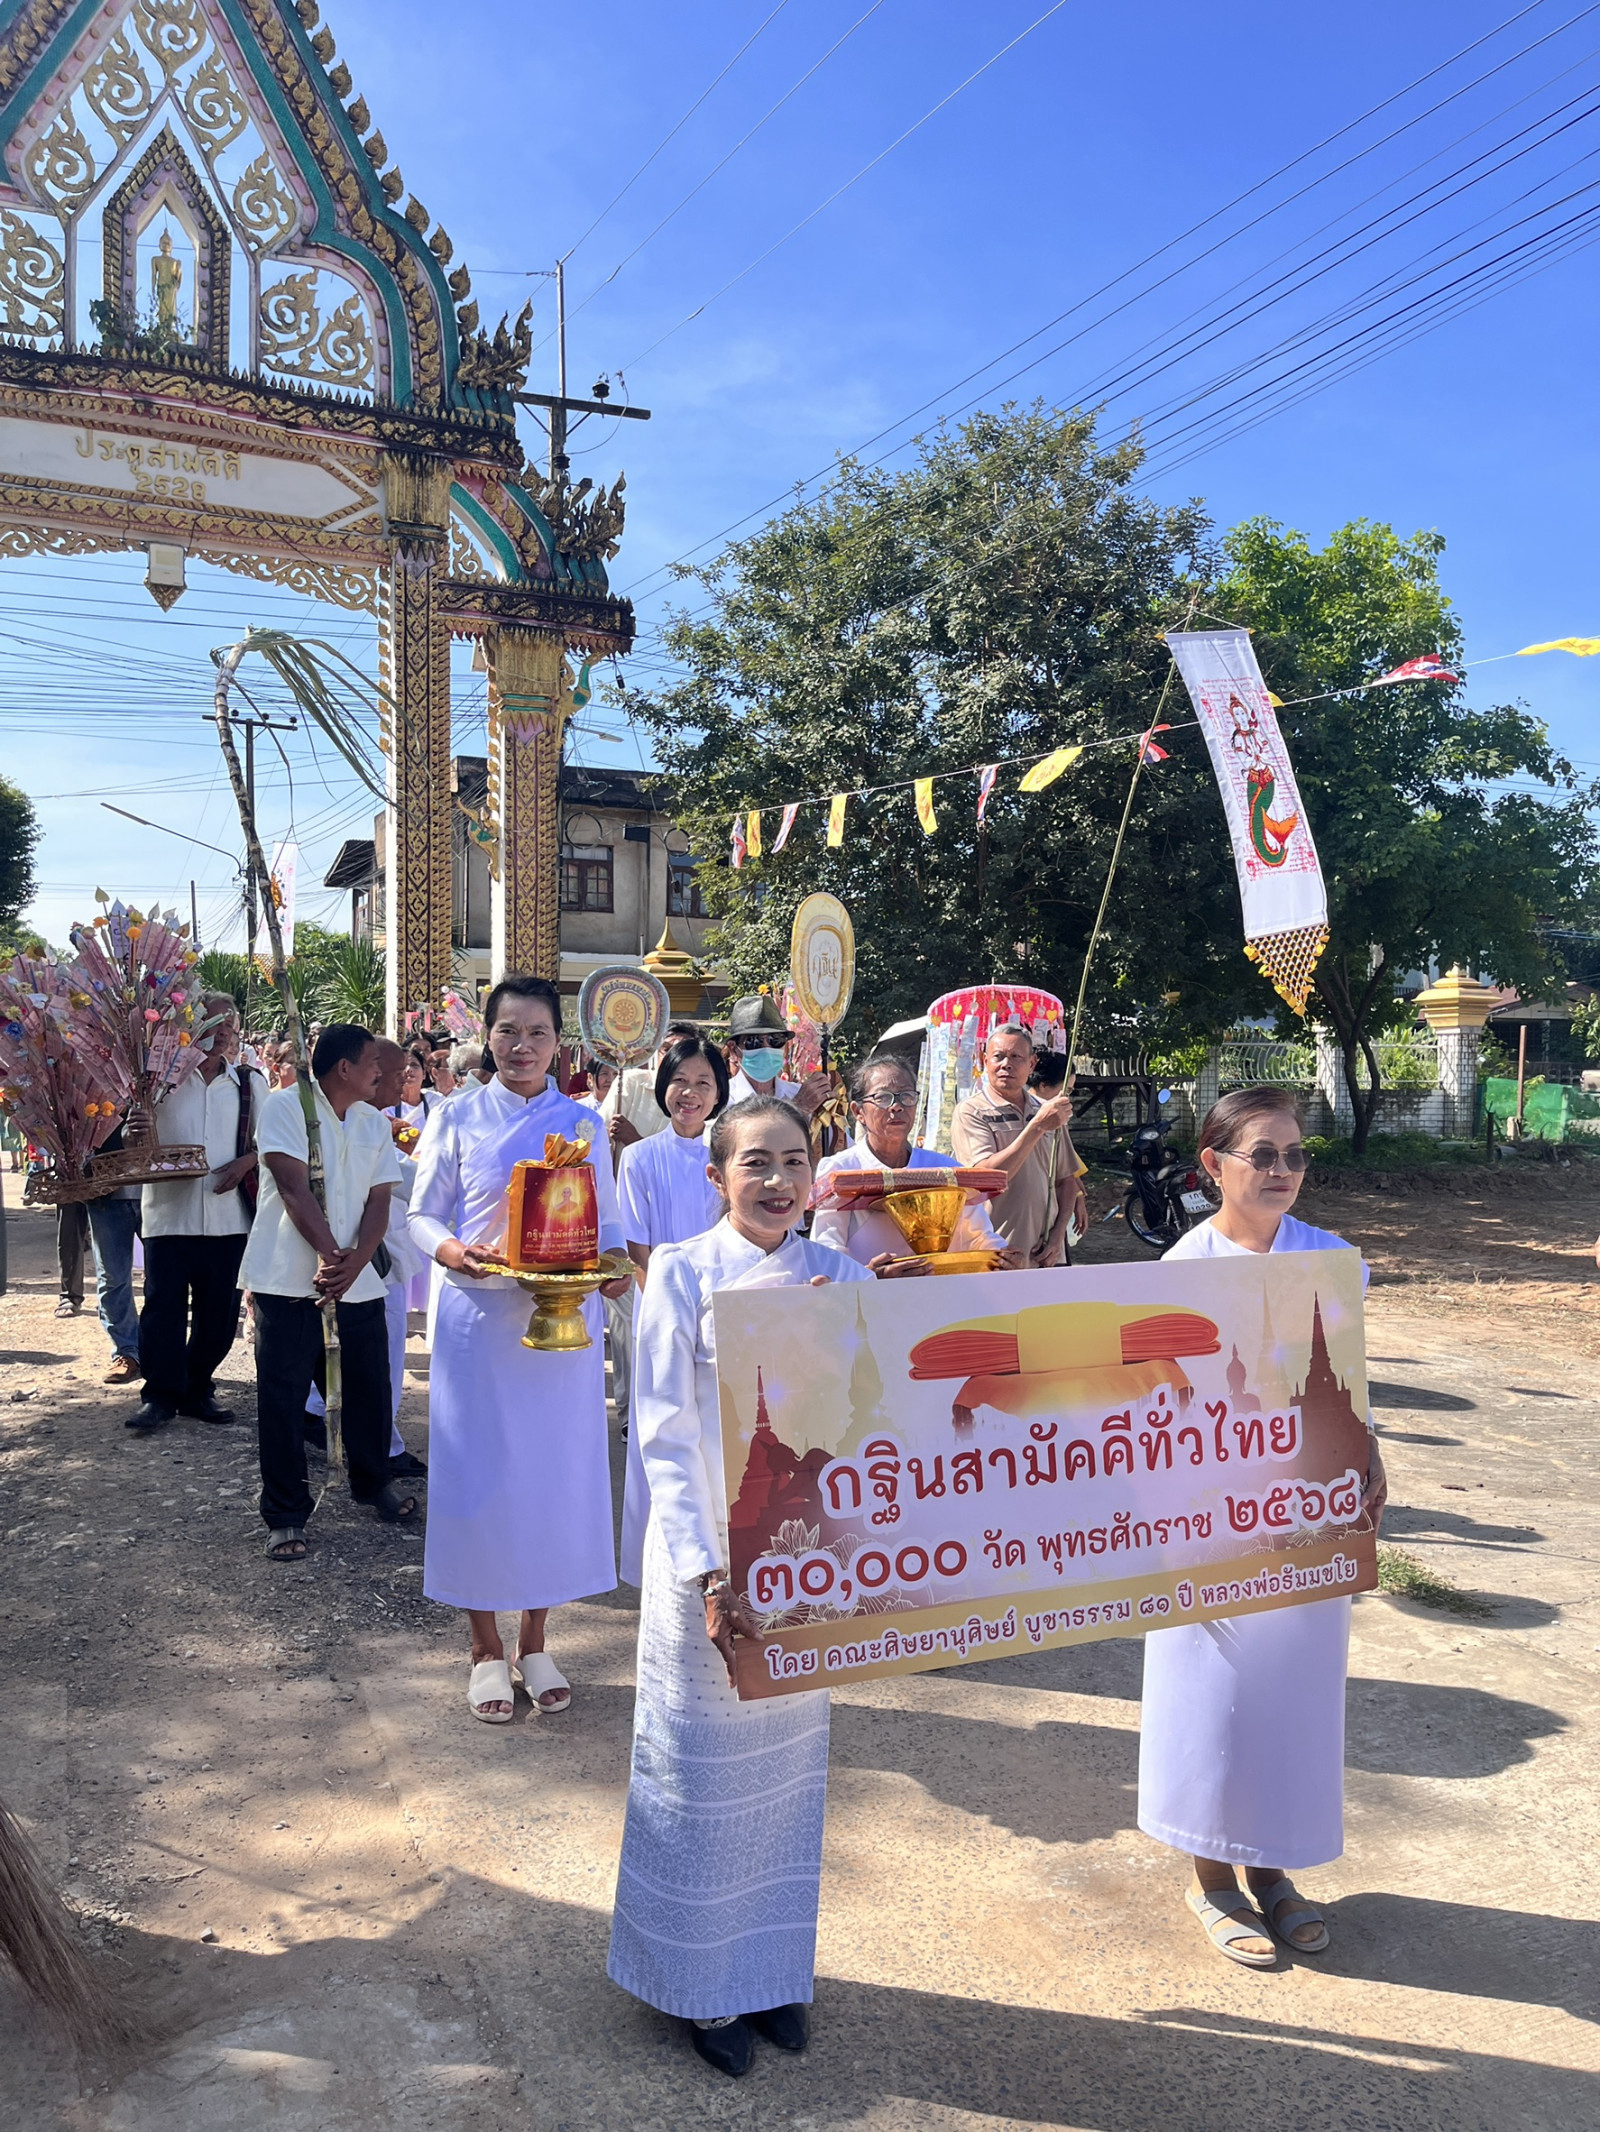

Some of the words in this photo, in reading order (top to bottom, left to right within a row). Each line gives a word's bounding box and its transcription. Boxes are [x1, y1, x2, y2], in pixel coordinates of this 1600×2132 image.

[75, 428, 242, 481] ประตูสามัคคี
[136, 472, 207, 502] 2528
[825, 1391, 1298, 1526] กฐินสามัคคีทั่วไทย
[755, 1539, 968, 1604] ๓๐,๐๐๐
[983, 1528, 1027, 1569] วัด
[1037, 1510, 1213, 1576] พุทธศักราช
[1225, 1474, 1361, 1533] ๒๕๖๘
[767, 1648, 816, 1677] โดย
[827, 1608, 1016, 1667] คณะศิษยานุศิษย์
[1025, 1600, 1131, 1642] บูชาธรรม
[1140, 1596, 1170, 1615] ๘๑
[1178, 1583, 1193, 1609] ปี
[1200, 1556, 1357, 1605] หลวงพ่อธัมมชโย
